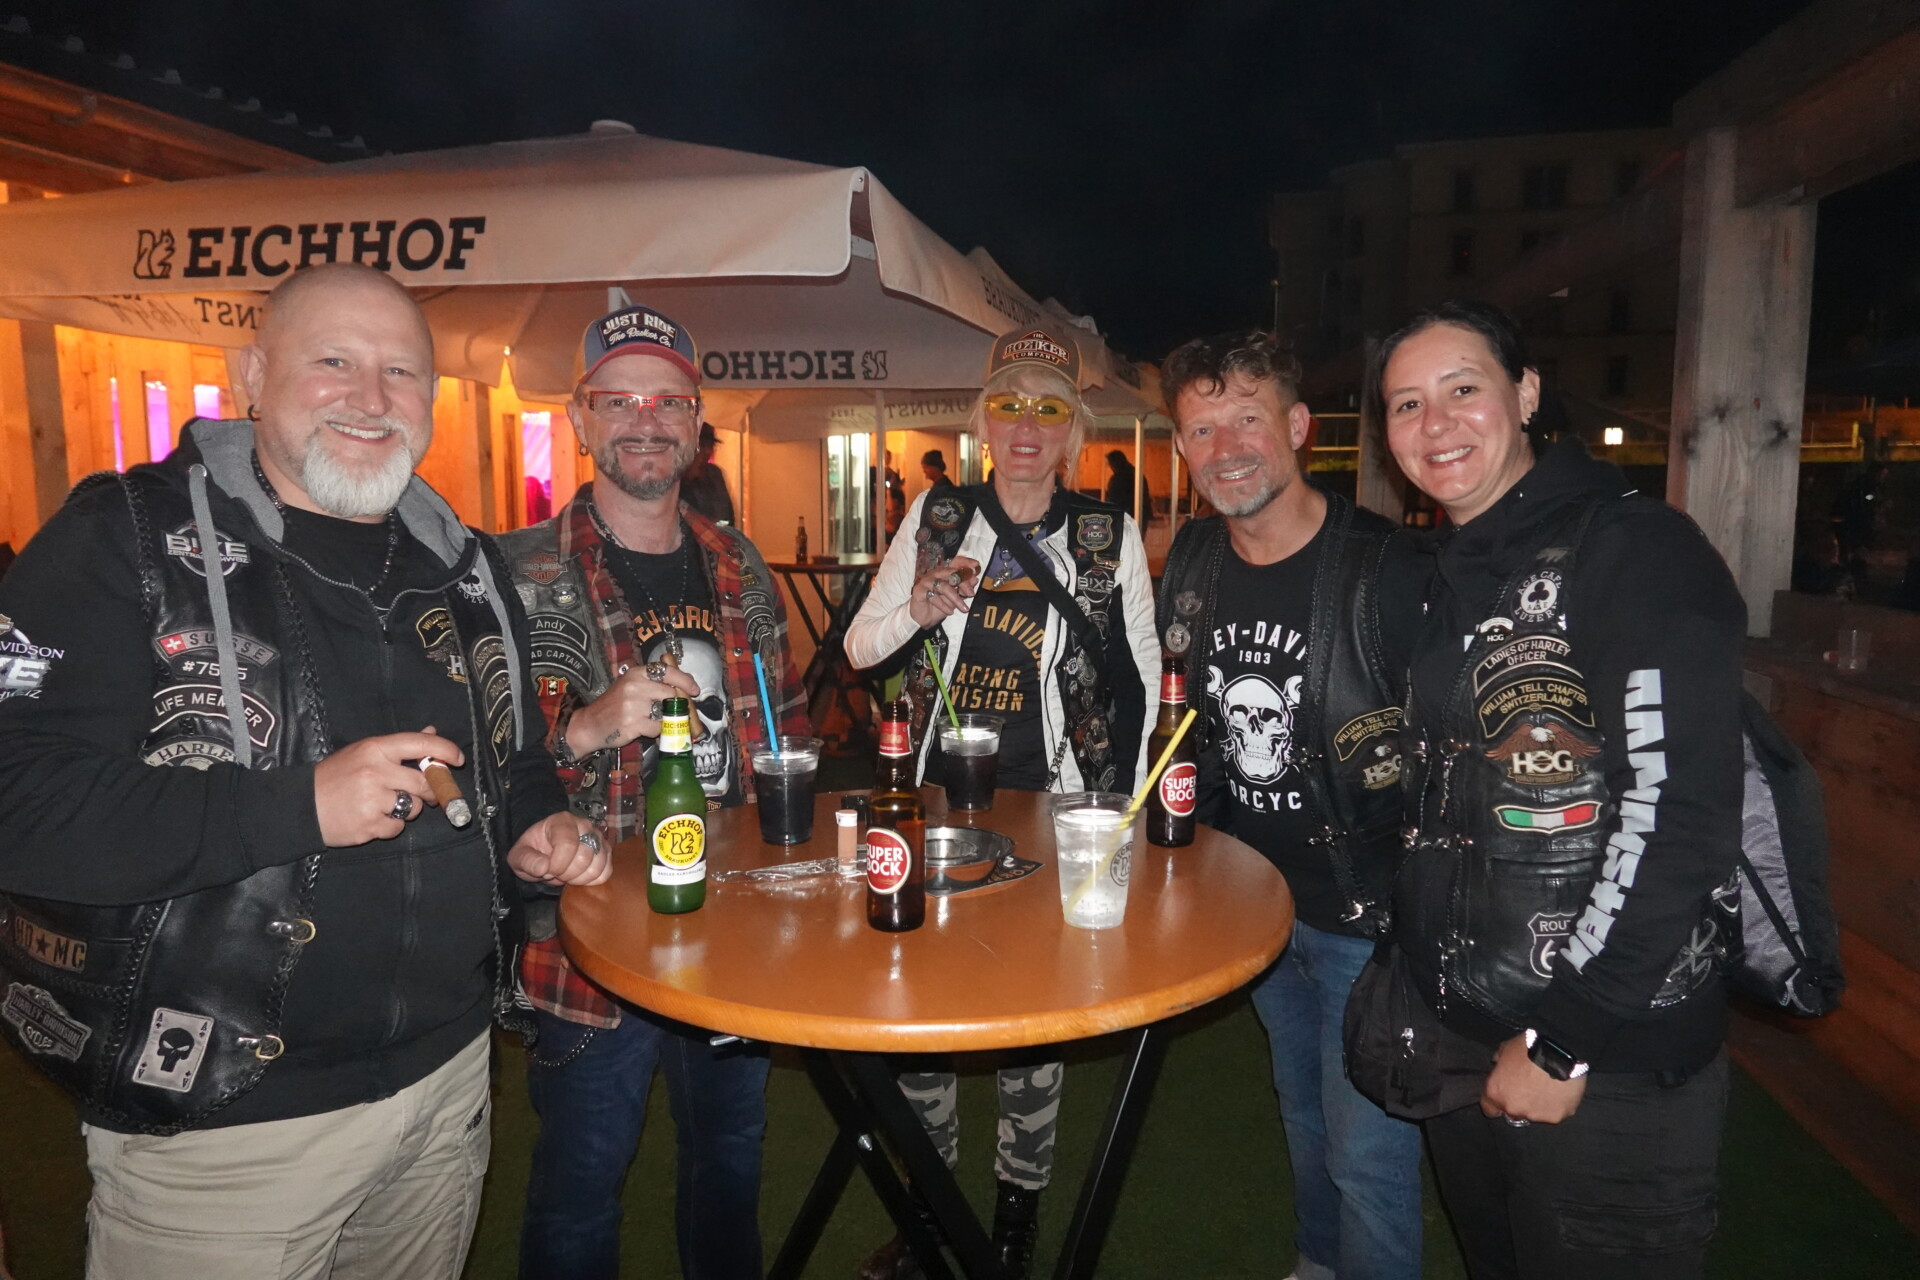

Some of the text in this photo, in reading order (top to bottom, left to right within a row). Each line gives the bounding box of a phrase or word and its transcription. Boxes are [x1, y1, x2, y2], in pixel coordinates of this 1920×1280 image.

[183, 216, 486, 278] EICHHOF
[603, 312, 677, 338] JUST RIDE
[608, 331, 626, 346] The
[1015, 351, 1057, 366] COMPANY
[535, 618, 566, 632] Andy
[0, 640, 66, 660] VIDSON
[188, 633, 266, 660] SUSSE
[1486, 633, 1505, 643] HOG
[546, 649, 583, 671] CAPTAIN
[1239, 650, 1272, 665] 1903
[1483, 639, 1572, 671] LADIES OF HARLEY
[1507, 651, 1548, 667] OFFICER
[182, 660, 248, 681] #755
[955, 662, 1022, 691] ACING
[154, 691, 264, 728] LIFE MEMER
[951, 685, 1024, 712] VISION
[1482, 687, 1518, 717] WILLIAM
[1519, 682, 1545, 694] TELL
[1499, 692, 1574, 716] SWITZERLAND
[1336, 721, 1364, 745] WILLIAM
[1363, 714, 1383, 726] TELL
[1511, 749, 1575, 775] HOG
[1226, 772, 1304, 811] ORCYC
[658, 818, 704, 841] EICHHOF
[1538, 919, 1572, 933] ROU
[53, 939, 86, 969] MC
